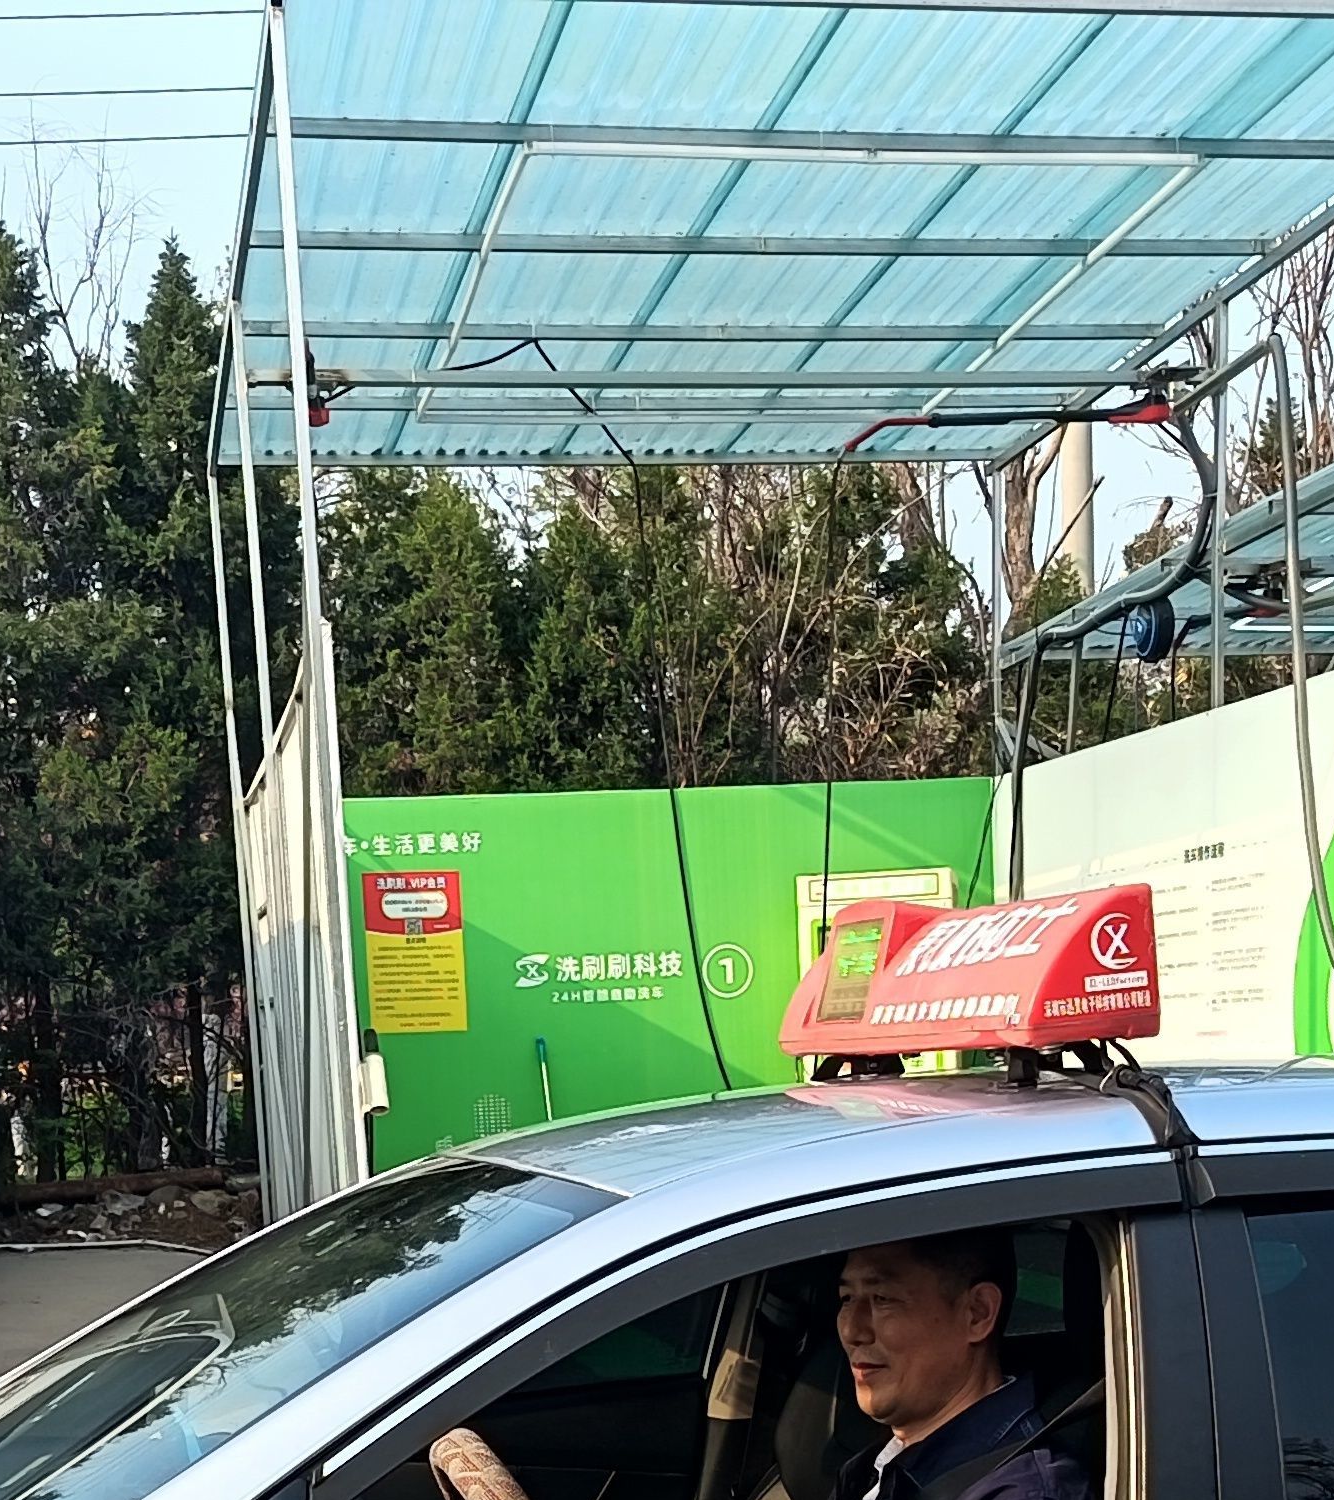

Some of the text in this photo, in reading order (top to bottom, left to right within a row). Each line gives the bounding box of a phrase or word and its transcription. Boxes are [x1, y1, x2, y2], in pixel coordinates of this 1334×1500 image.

[555, 951, 683, 982] 洗刷刷科技
